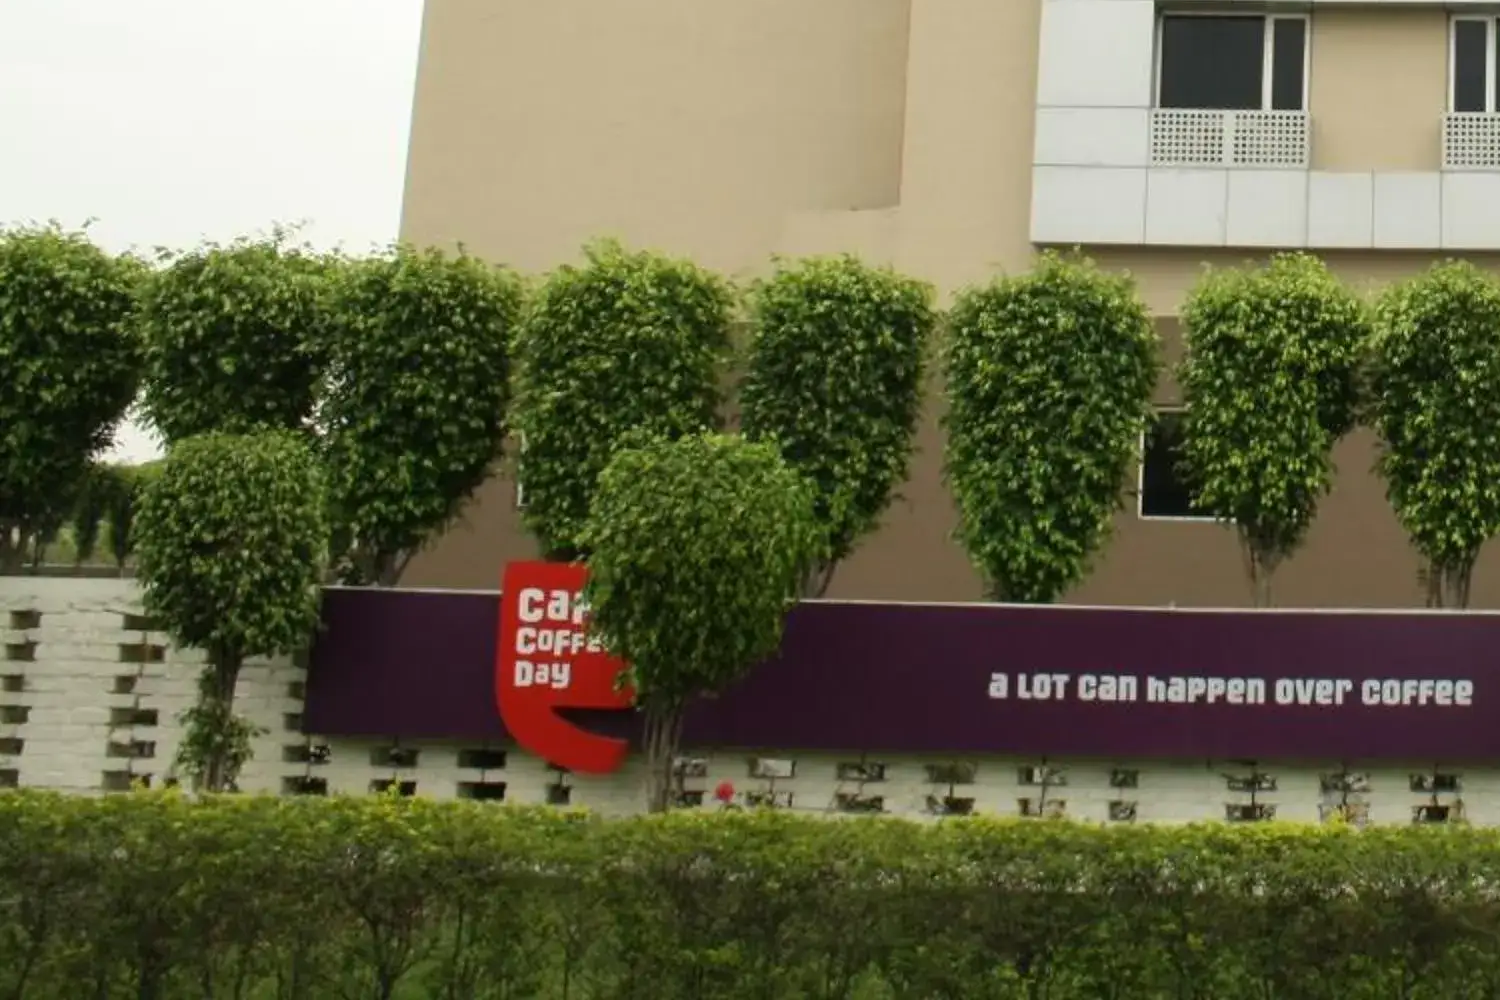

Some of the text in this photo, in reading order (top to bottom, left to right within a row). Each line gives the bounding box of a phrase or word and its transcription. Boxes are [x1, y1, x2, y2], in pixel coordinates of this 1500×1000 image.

[515, 626, 609, 656] Coffe
[514, 660, 571, 689] Day
[989, 672, 1009, 699] a
[1017, 673, 1070, 700] LOT
[1275, 678, 1353, 705] over
